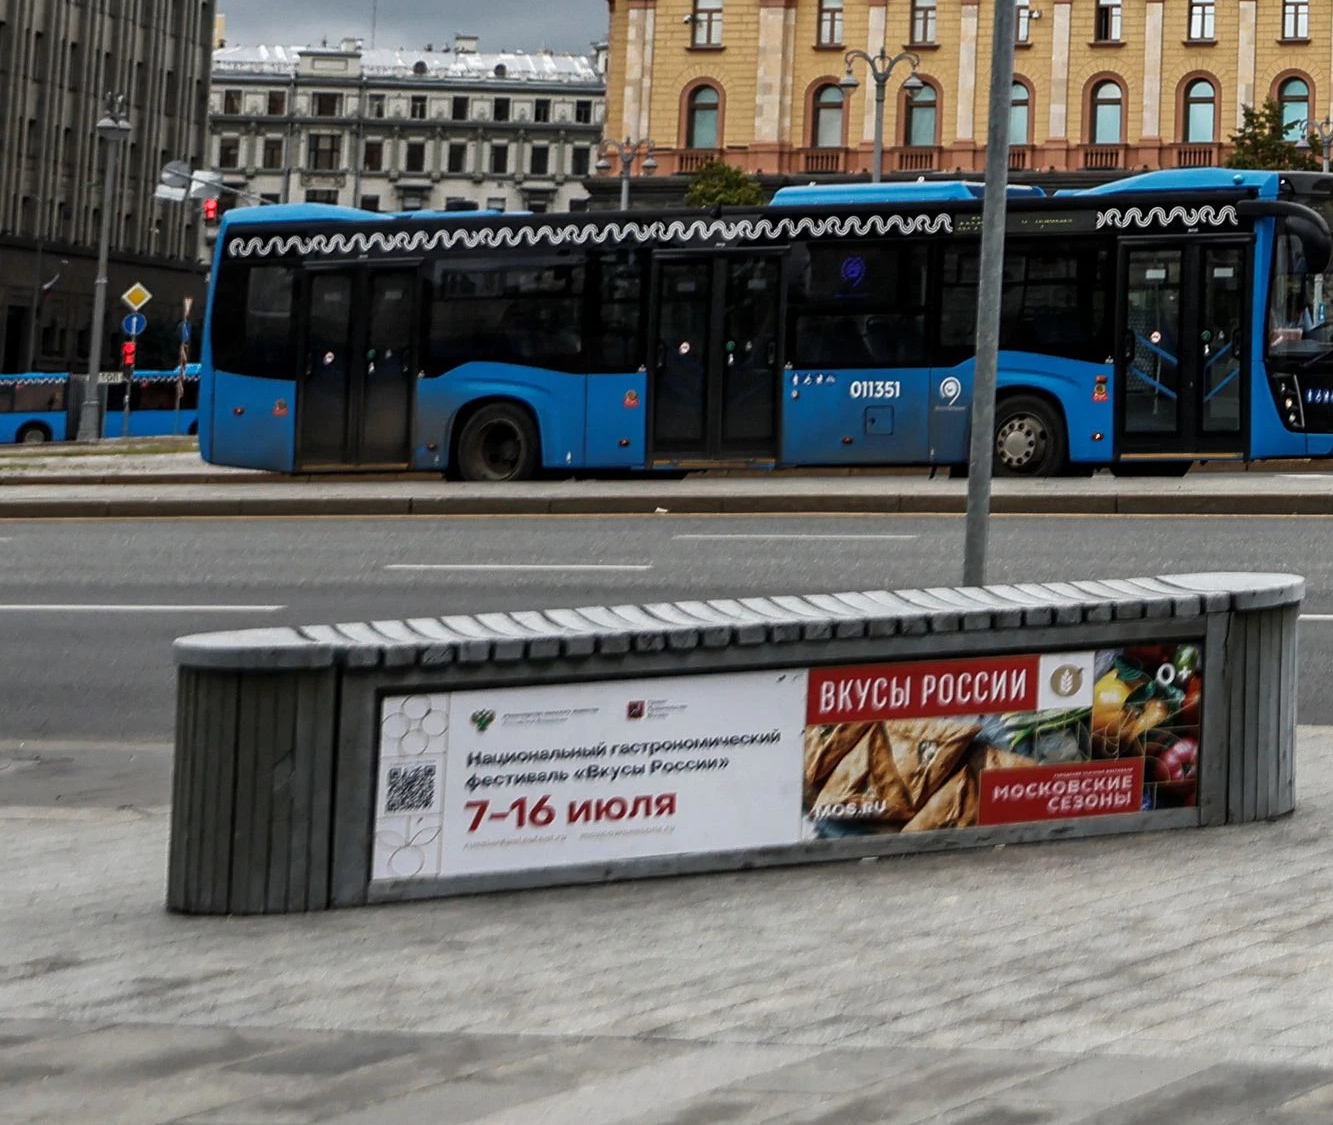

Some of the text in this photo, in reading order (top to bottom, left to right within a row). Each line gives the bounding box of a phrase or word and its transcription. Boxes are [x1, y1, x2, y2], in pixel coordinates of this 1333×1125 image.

[849, 380, 901, 399] 011351
[1156, 662, 1193, 686] 0+
[819, 668, 1027, 715] ВКУСЫ РОССИИ
[467, 728, 781, 768] Национальный гастрономический
[464, 757, 730, 794] фестиваль «Вкусы России»
[992, 774, 1133, 802] МОСКОВСКИЕ
[567, 791, 678, 825] июля
[814, 799, 887, 820] MOS.RU
[1046, 790, 1132, 813] СЕЗОНЫ
